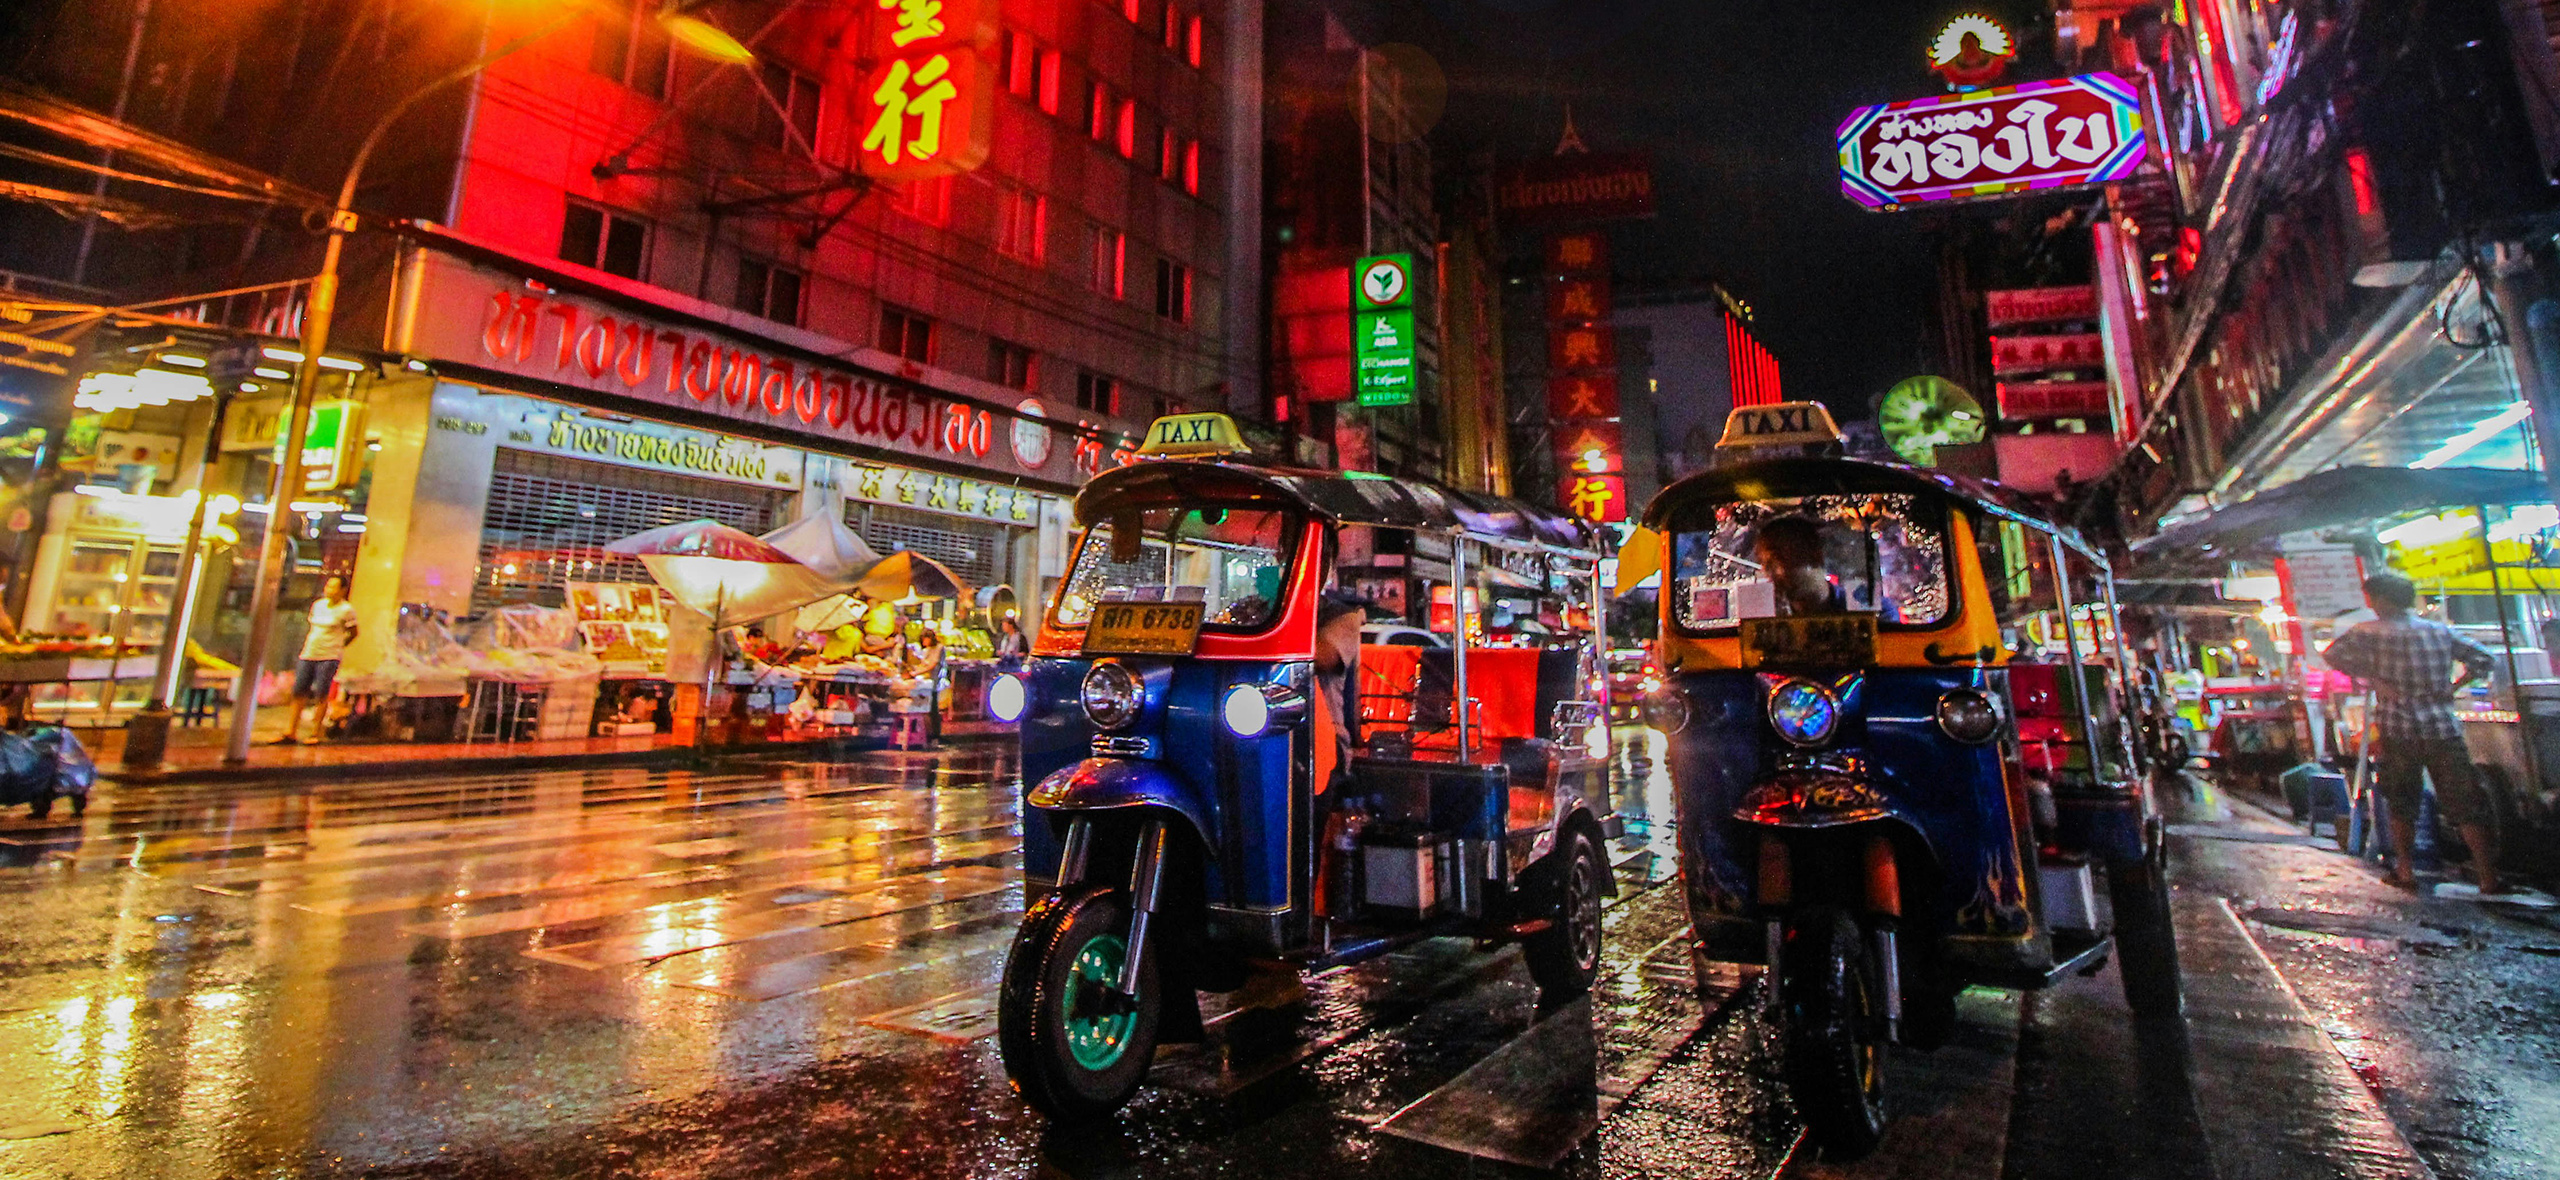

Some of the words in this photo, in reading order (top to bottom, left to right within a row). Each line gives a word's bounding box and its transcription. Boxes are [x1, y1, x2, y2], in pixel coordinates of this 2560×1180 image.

[1159, 419, 1214, 443] TAXI
[1741, 408, 1812, 434] TAXI
[1143, 607, 1195, 630] 6738
